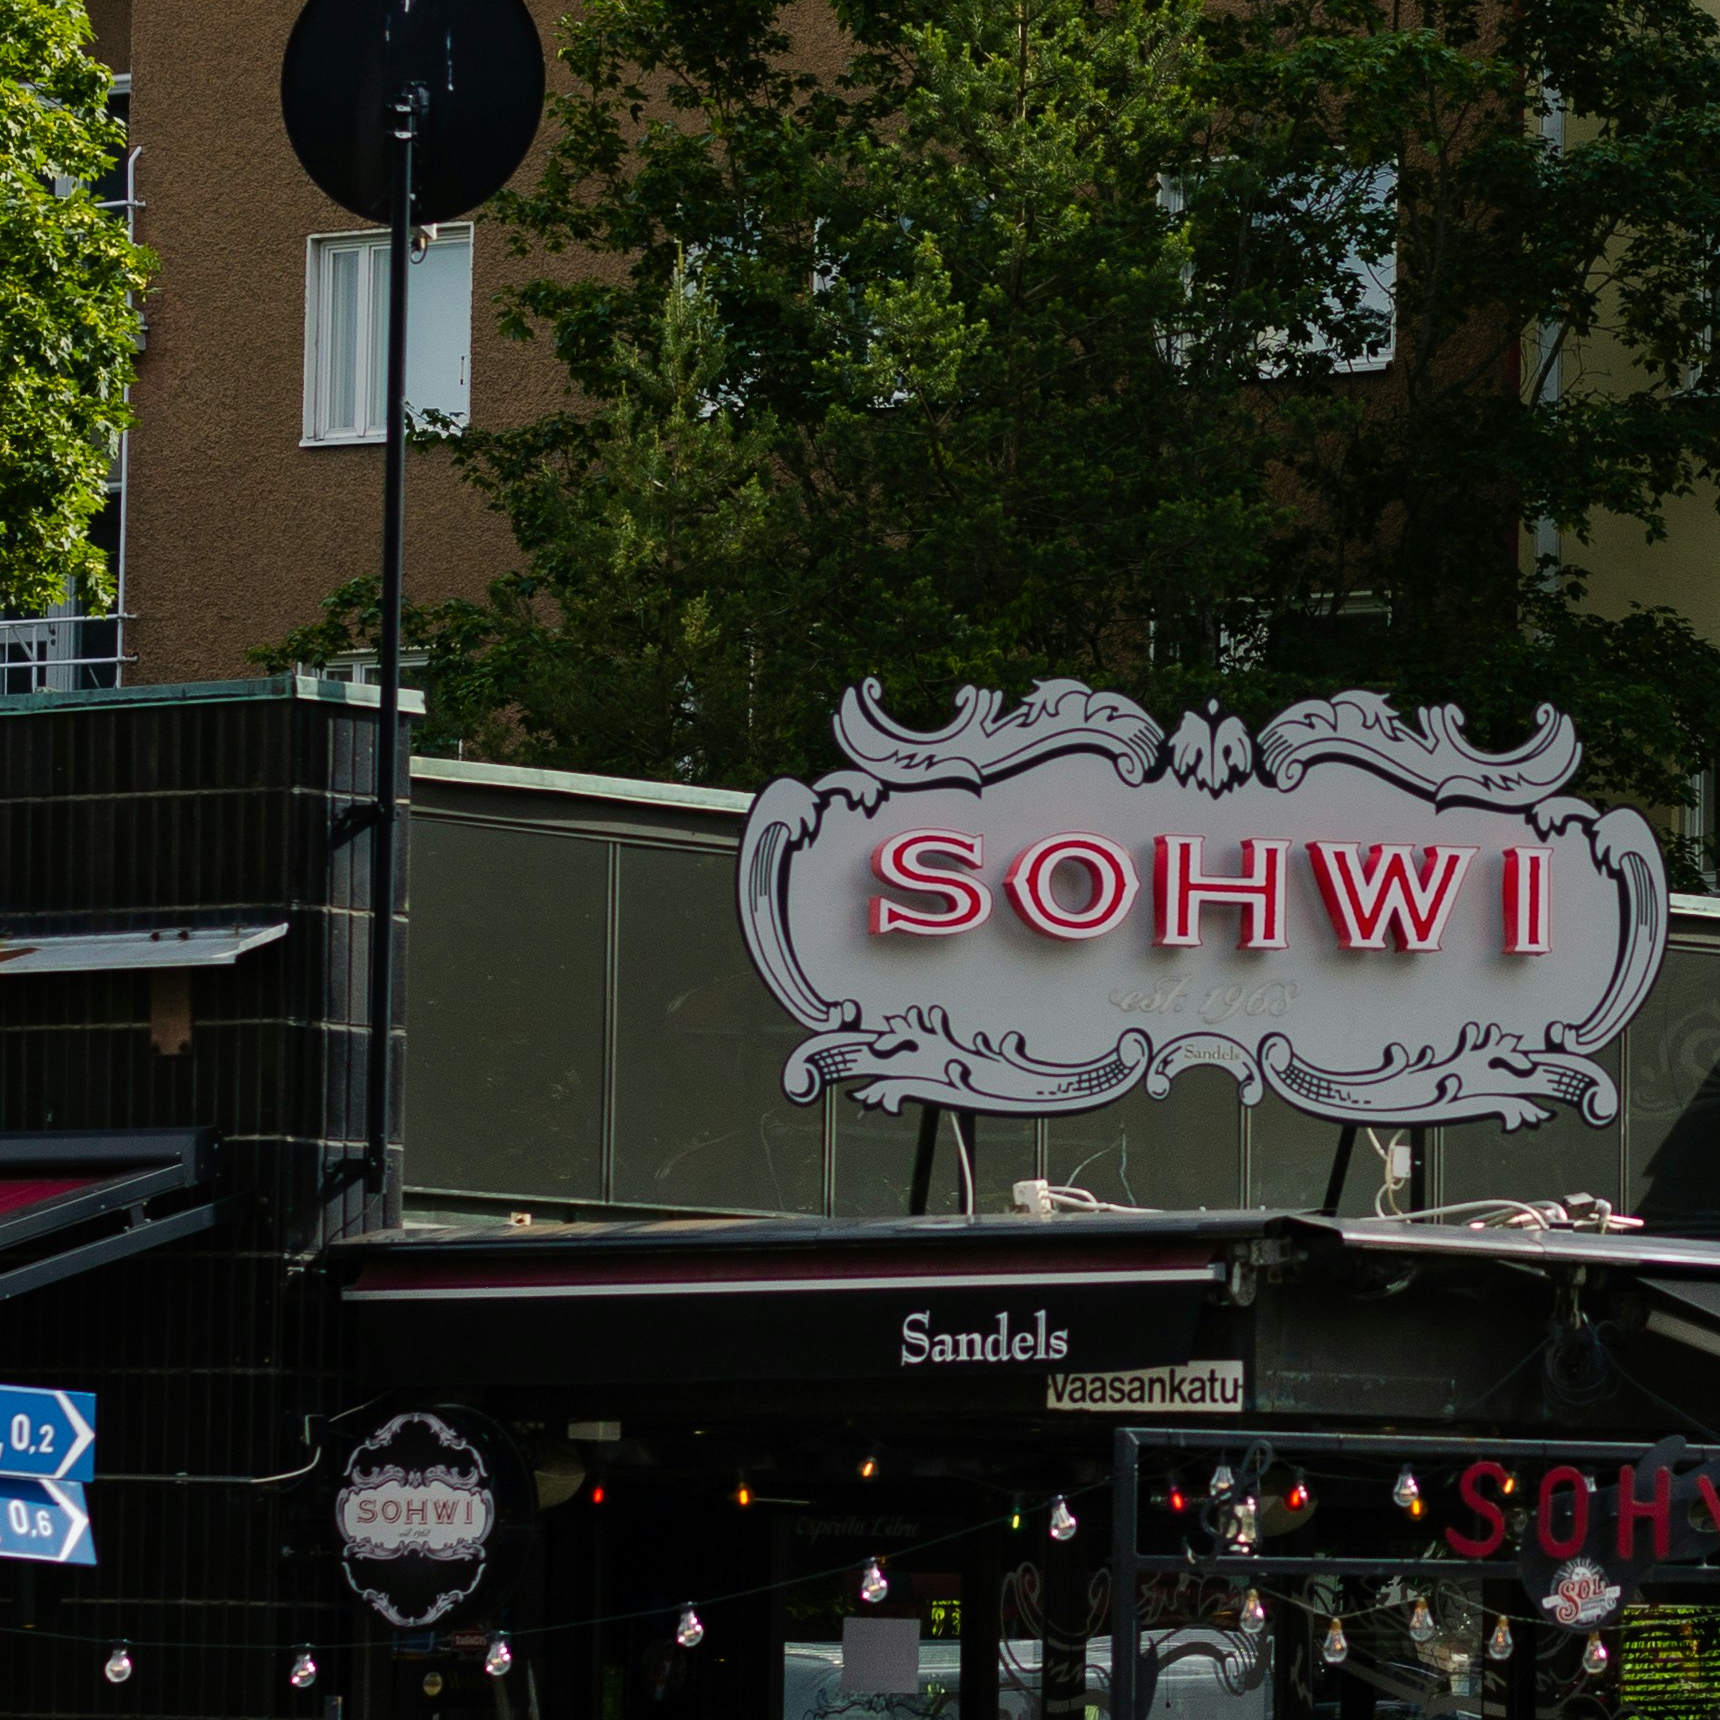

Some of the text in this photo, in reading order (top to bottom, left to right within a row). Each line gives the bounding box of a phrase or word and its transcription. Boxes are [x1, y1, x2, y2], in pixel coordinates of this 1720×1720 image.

[867, 828, 1555, 957] SOHWI
[1199, 977, 1300, 1026] 1968
[1184, 1044, 1242, 1061] Sandels
[901, 1309, 1069, 1367] Sandels
[1049, 1367, 1241, 1406] Vaasankatu
[11, 1412, 55, 1455] 0,2
[8, 1499, 53, 1538] 0,6
[356, 1499, 473, 1525] SOHWI
[1556, 1574, 1606, 1625] SOL
